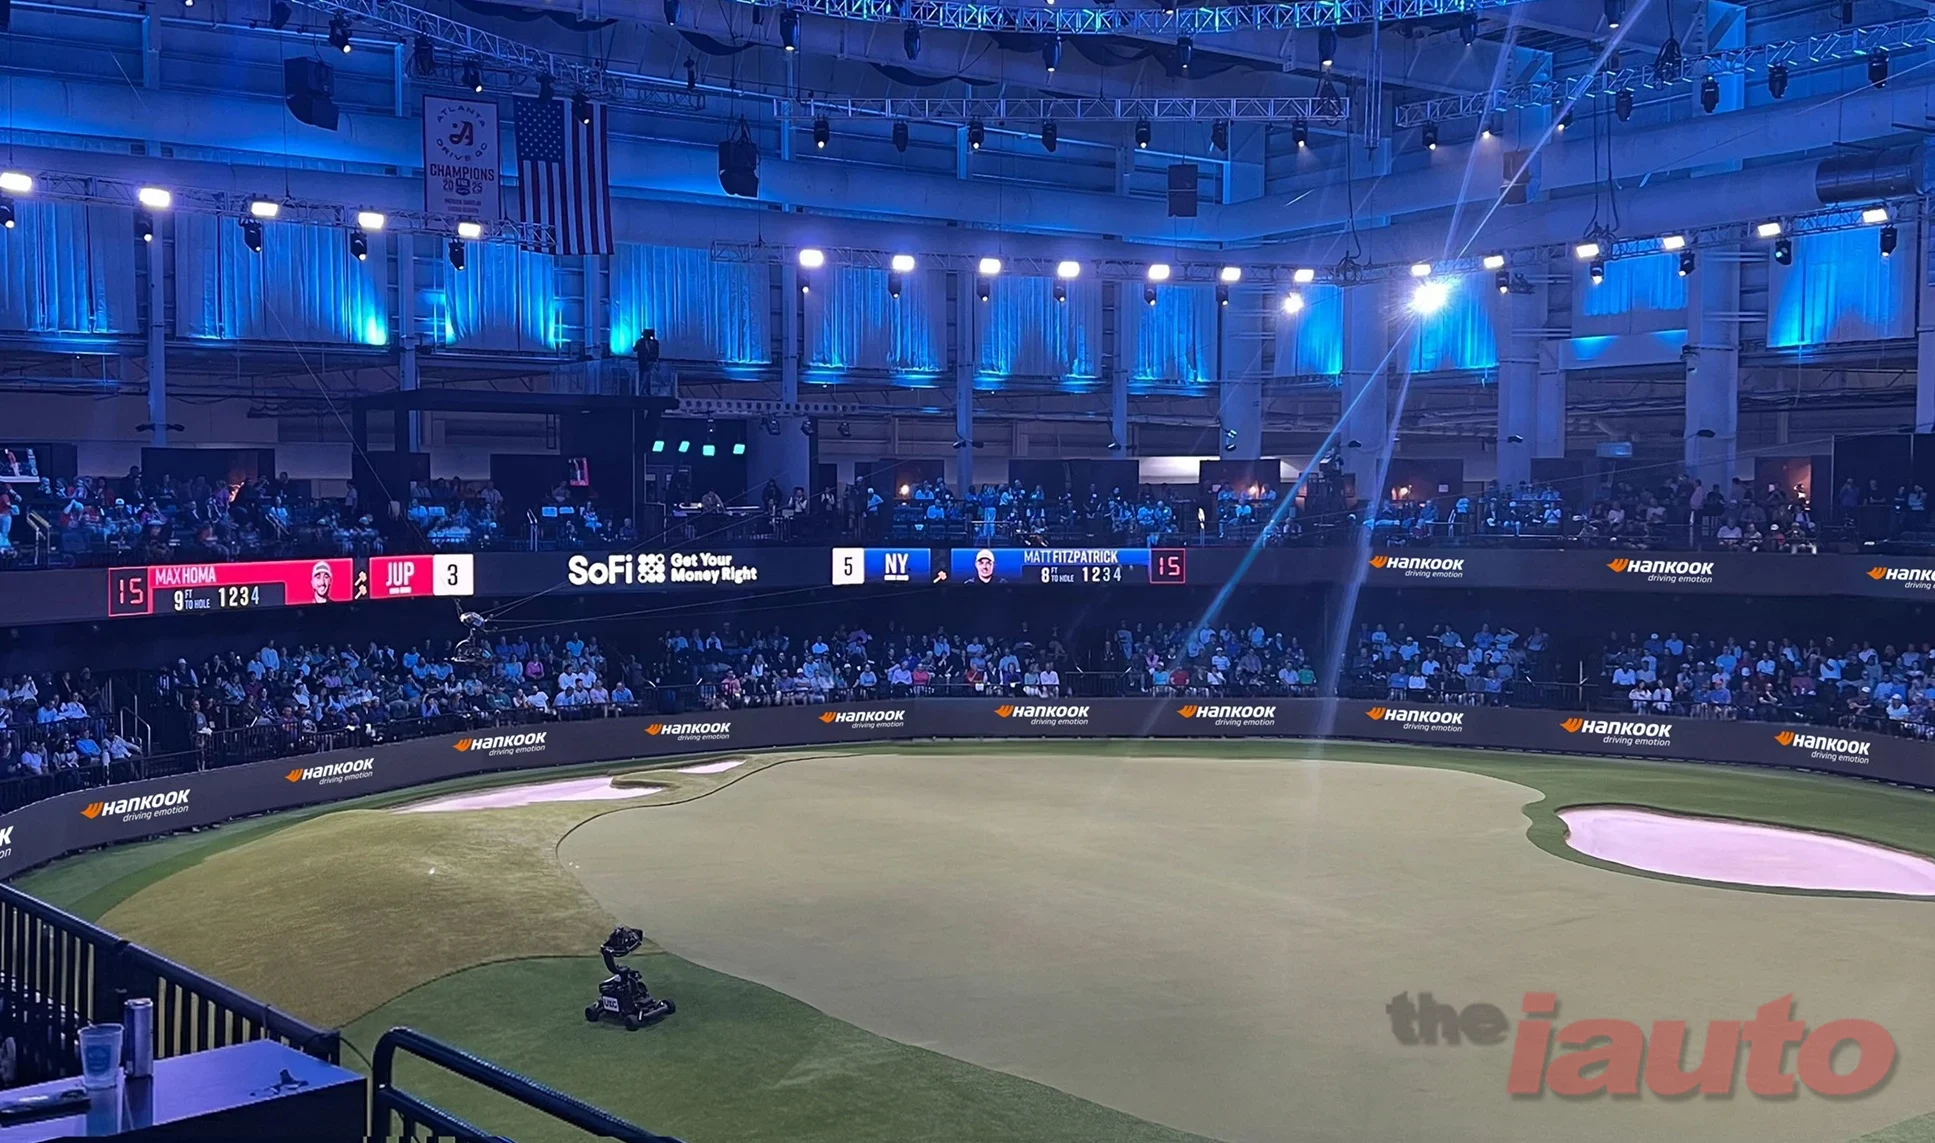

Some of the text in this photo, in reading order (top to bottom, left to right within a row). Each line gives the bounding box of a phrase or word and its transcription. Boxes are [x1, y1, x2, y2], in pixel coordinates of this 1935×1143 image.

[437, 105, 486, 127] ATLANTA
[430, 163, 495, 181] CHAMPIONS
[670, 553, 732, 567] Get Your
[885, 553, 909, 574] NY
[1024, 550, 1118, 563] MATT FITZPATRICK
[385, 561, 415, 586] JUP
[568, 554, 633, 585] SoFi
[844, 557, 853, 576] 5
[1159, 557, 1180, 576] 15
[155, 566, 216, 585] MAX HOMA
[447, 564, 458, 586] 3
[670, 566, 757, 584] Money Right
[1041, 567, 1049, 583] 8
[1405, 569, 1463, 579] driving emotion
[1647, 574, 1713, 583] driving emotion
[1885, 568, 1935, 581] HANK
[1905, 581, 1931, 590] driving
[174, 589, 193, 611] 9 FT
[185, 599, 211, 610] TO HOLE
[1031, 718, 1056, 726] driving
[1215, 719, 1241, 727] driving
[1403, 723, 1429, 731] driving
[1602, 736, 1671, 746] driving emotion
[488, 745, 546, 756] driving emotion
[1811, 750, 1869, 764] driving emotion
[318, 771, 373, 785] driving emotion
[122, 805, 189, 822] driving emotion
